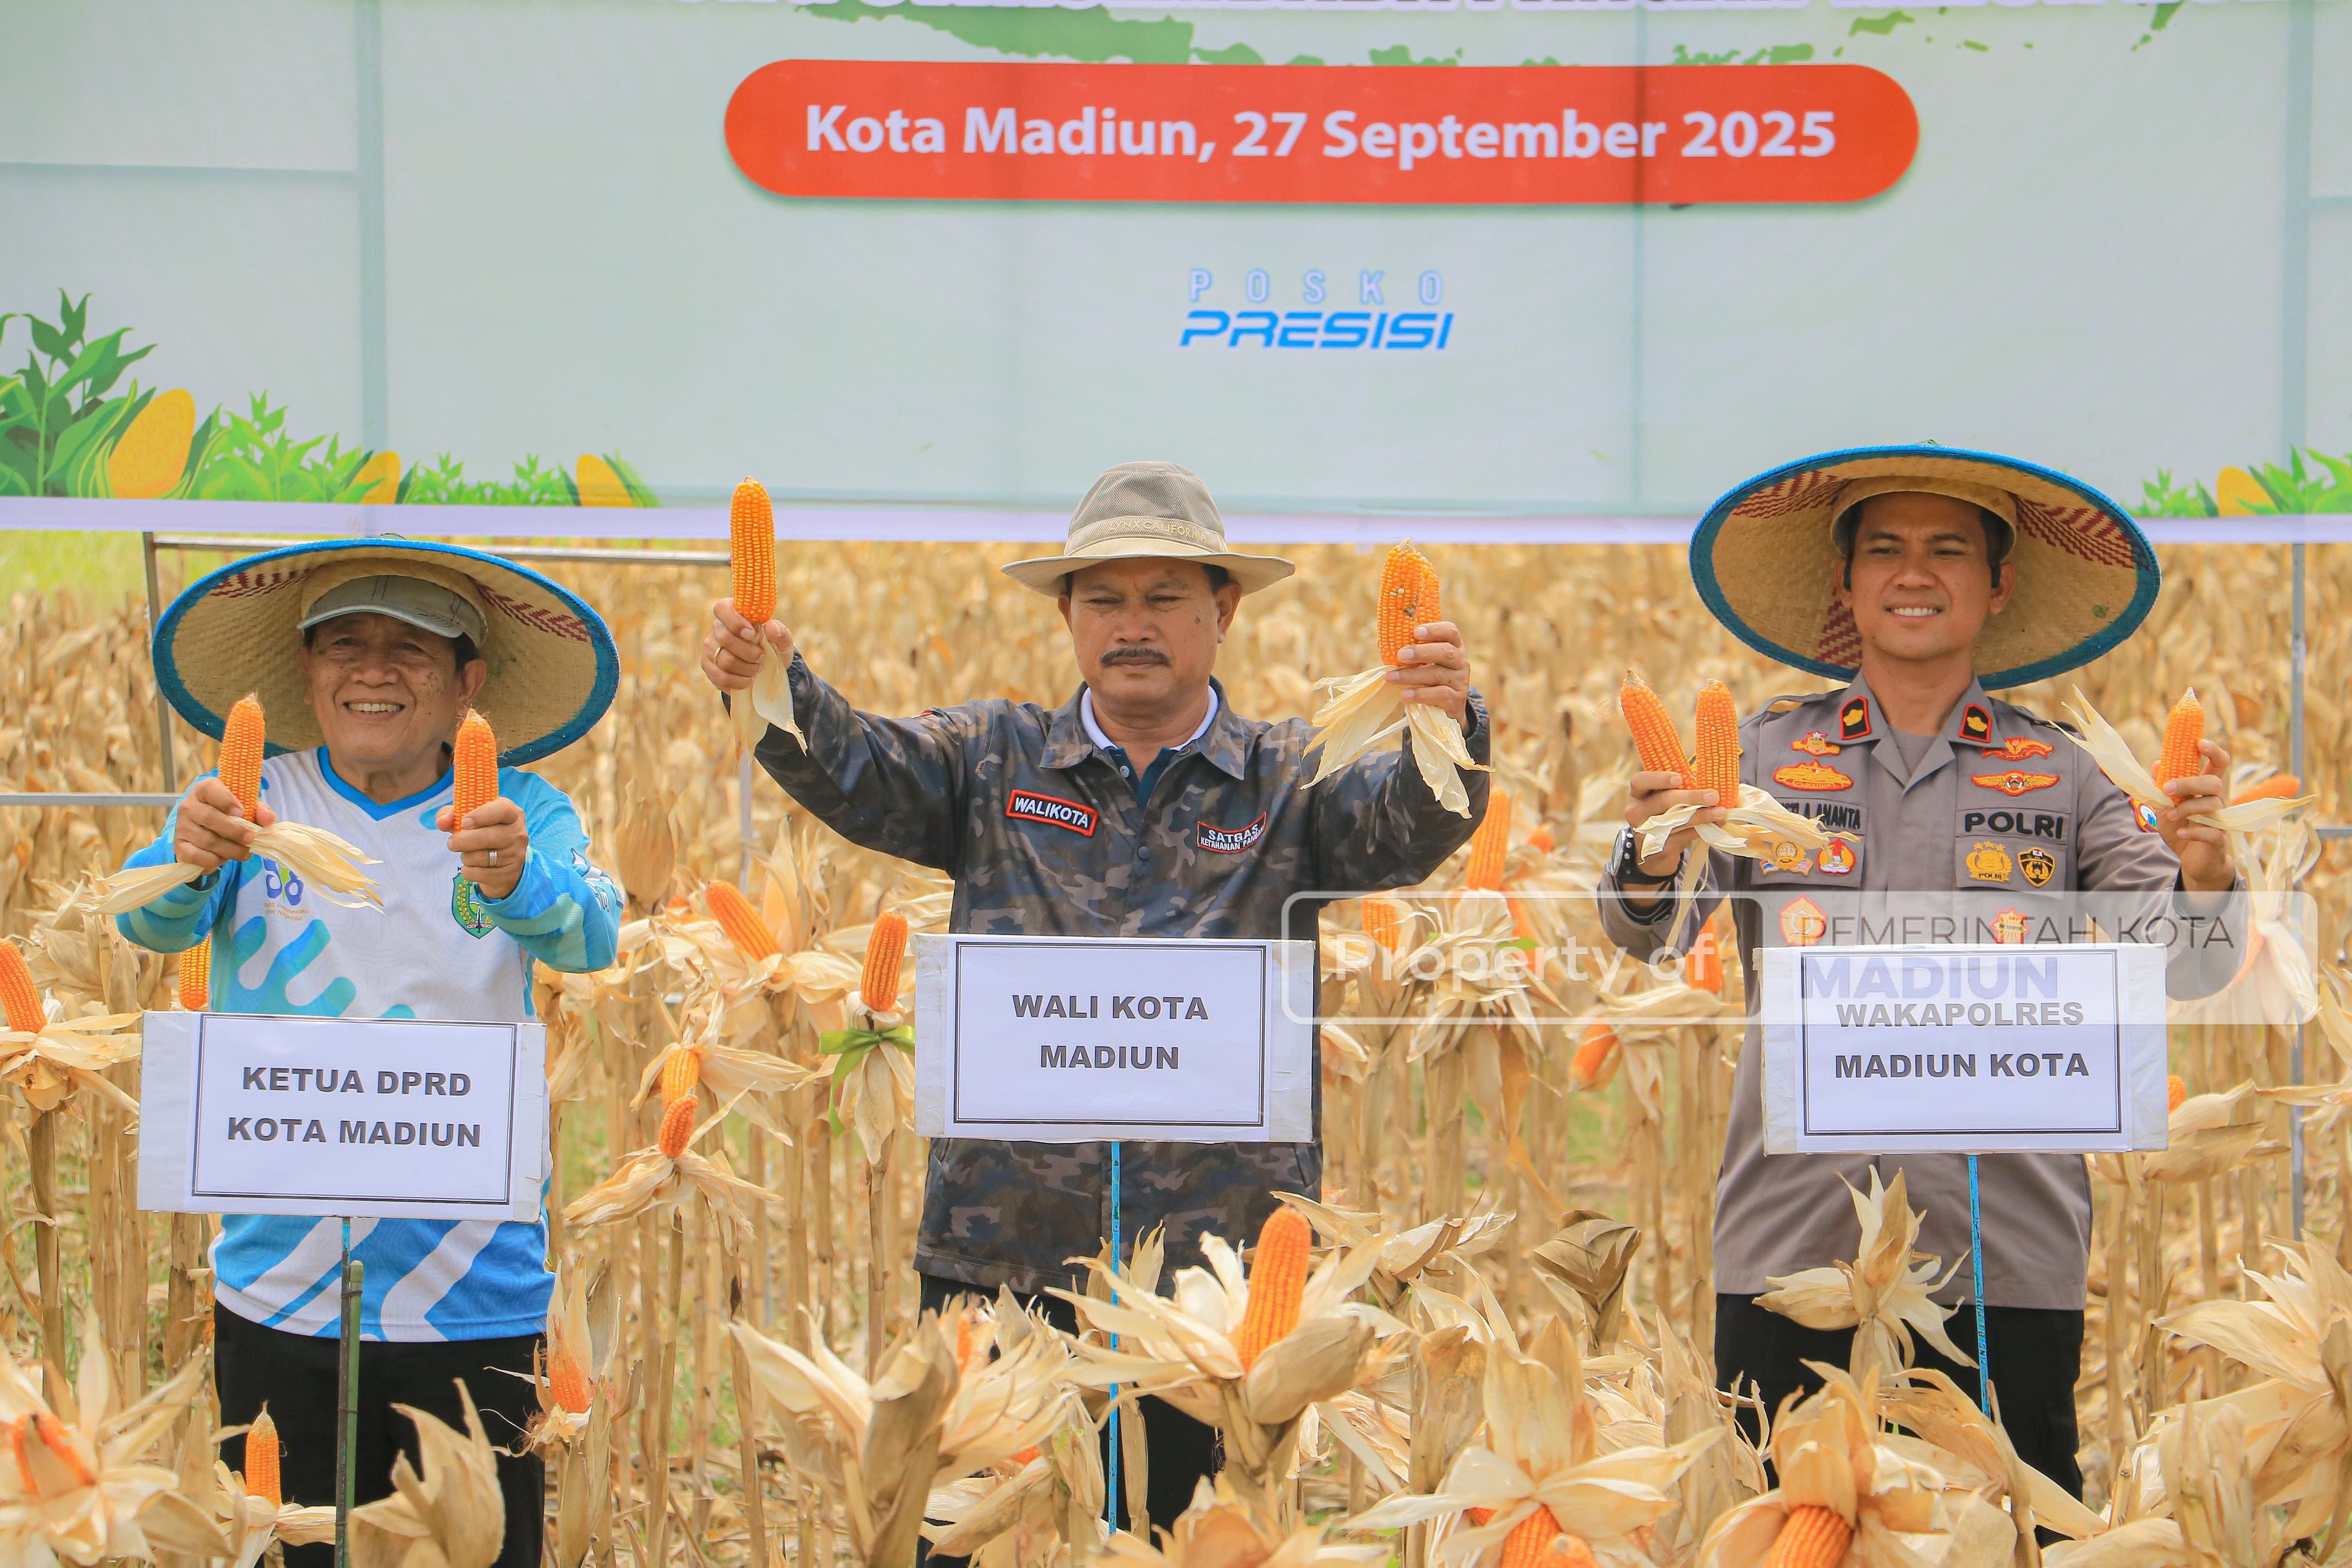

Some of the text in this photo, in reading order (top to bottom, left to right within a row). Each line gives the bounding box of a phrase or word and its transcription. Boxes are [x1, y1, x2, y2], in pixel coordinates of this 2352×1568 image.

[806, 105, 1835, 171] Kota Madiun, 27 September 2025
[1189, 268, 1443, 305] POSKO
[1179, 310, 1454, 349] PRESISI
[1143, 521, 1208, 542] CALIFORNIA
[1015, 797, 1088, 828] WALIKOTA
[1965, 811, 2064, 840] POLRI
[1200, 837, 1240, 851] KETAHANAN
[1208, 824, 1259, 843] SATGAS
[1012, 995, 1209, 1020] WALI KOTA
[1836, 1002, 2085, 1028] WAKAPOLRES
[1040, 1045, 1179, 1070] MADIUN
[1835, 1053, 2090, 1079] MADIUN KOTA
[243, 1067, 472, 1097] KETUA DPRD
[228, 1117, 481, 1148] KOTA MADIUN
